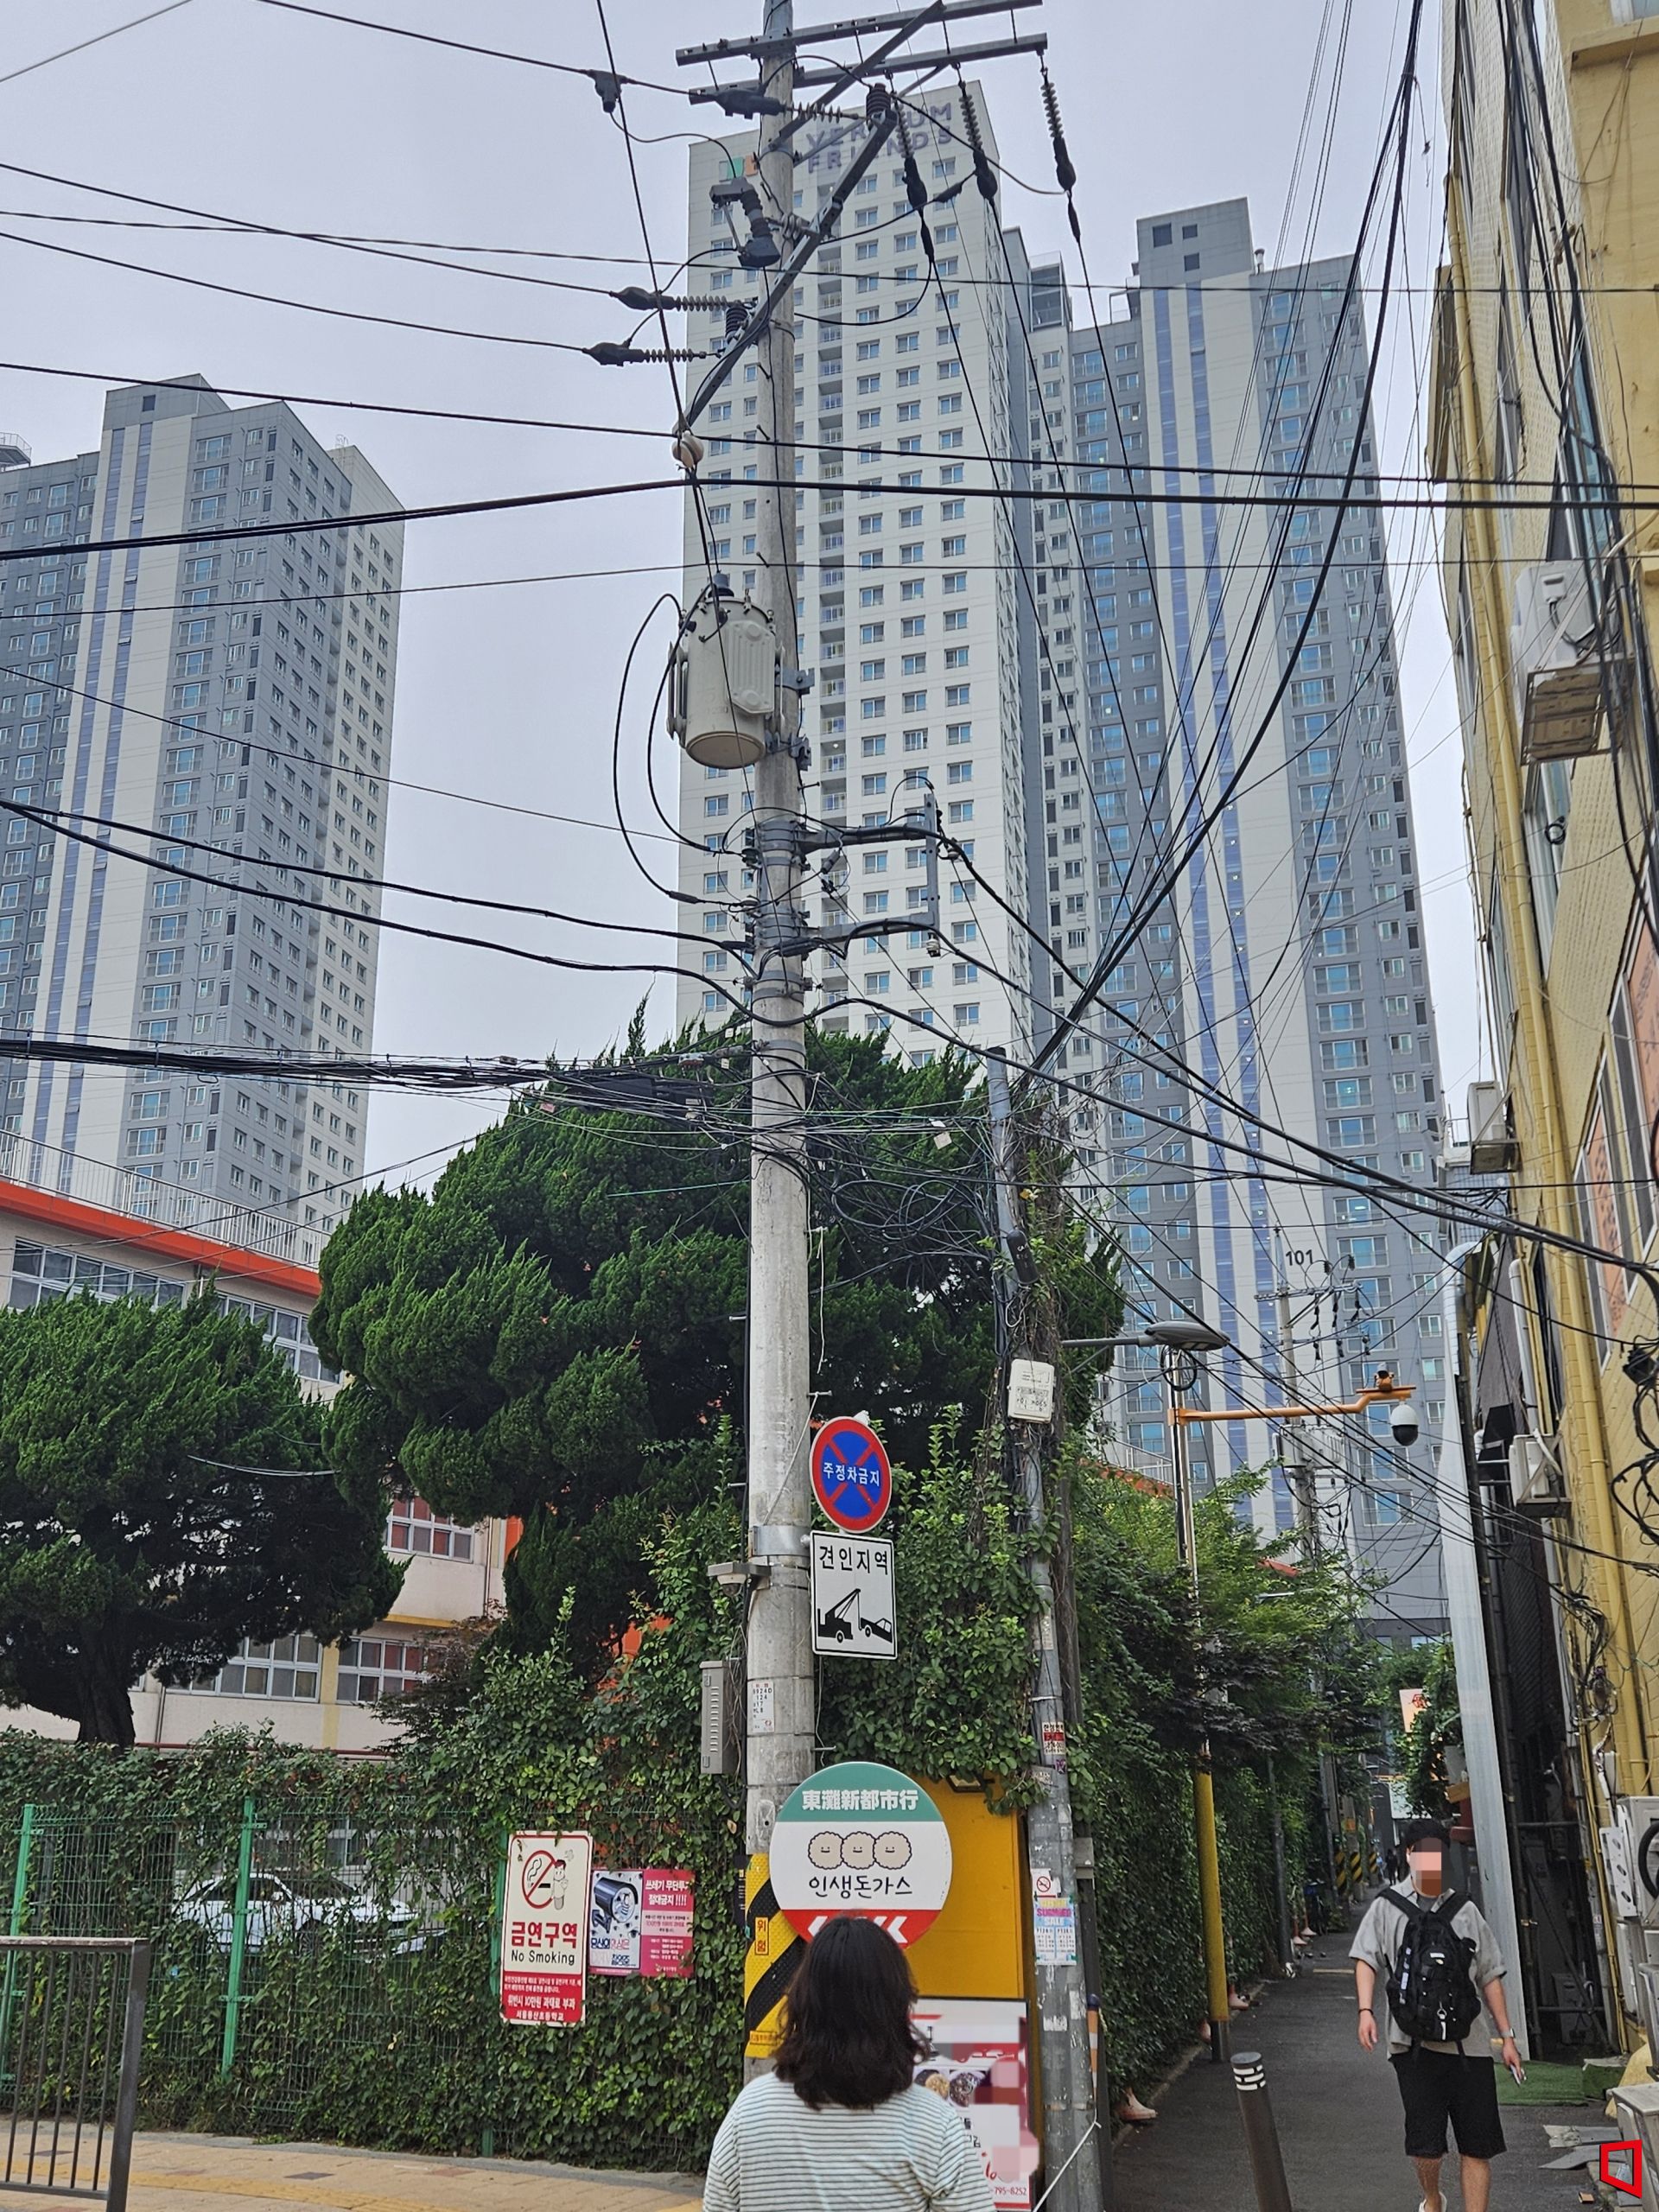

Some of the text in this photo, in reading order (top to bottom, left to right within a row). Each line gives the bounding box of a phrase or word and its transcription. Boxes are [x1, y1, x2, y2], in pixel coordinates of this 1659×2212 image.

[805, 102, 951, 153] VERUM
[807, 125, 952, 174] FRINDS
[1285, 1249, 1313, 1266] 101
[823, 1462, 880, 1487] 주정차금지
[819, 1545, 888, 1575] 견인지역
[802, 1789, 918, 1810] 東灘新都市行
[645, 1879, 664, 1891] 쓰레기
[809, 1875, 912, 1899] 인생돈가스
[512, 1922, 577, 1948] 금연구역
[757, 1919, 766, 1953] 위험
[511, 1949, 524, 1962] No
[529, 1949, 575, 1966] Smoking
